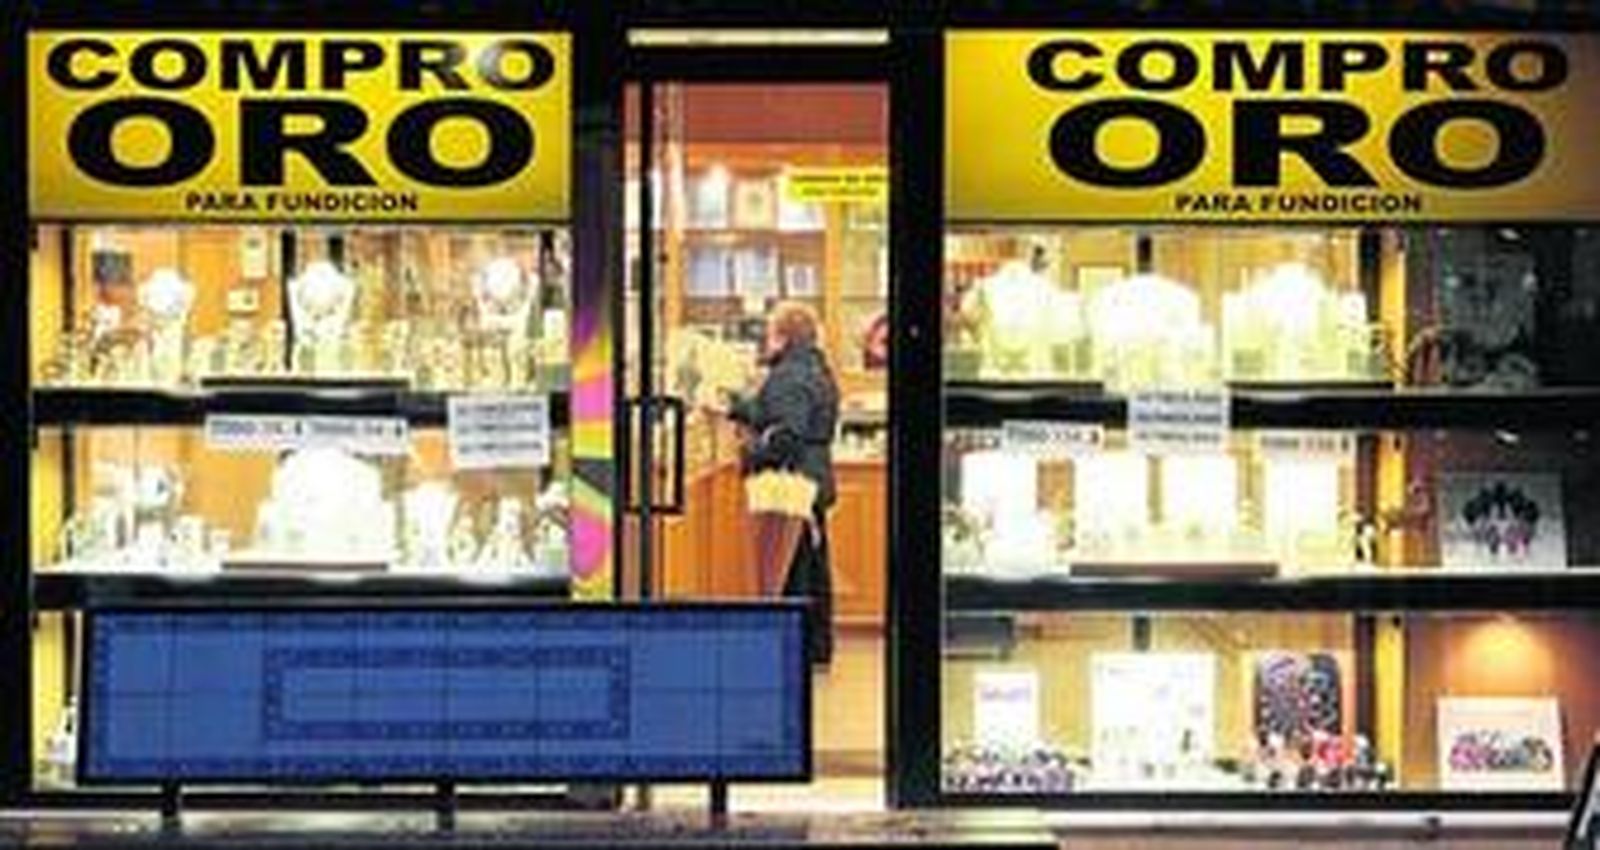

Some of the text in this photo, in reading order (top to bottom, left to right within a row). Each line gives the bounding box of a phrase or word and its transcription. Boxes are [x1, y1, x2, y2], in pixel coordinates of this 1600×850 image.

[46, 39, 556, 91] COMPRO
[1027, 40, 1569, 92] COMPRO
[67, 97, 536, 188] ORO
[1048, 97, 1546, 189] ORO
[185, 192, 418, 211] PARA FUNDICION
[1175, 193, 1422, 212] PARA FUNDICION
